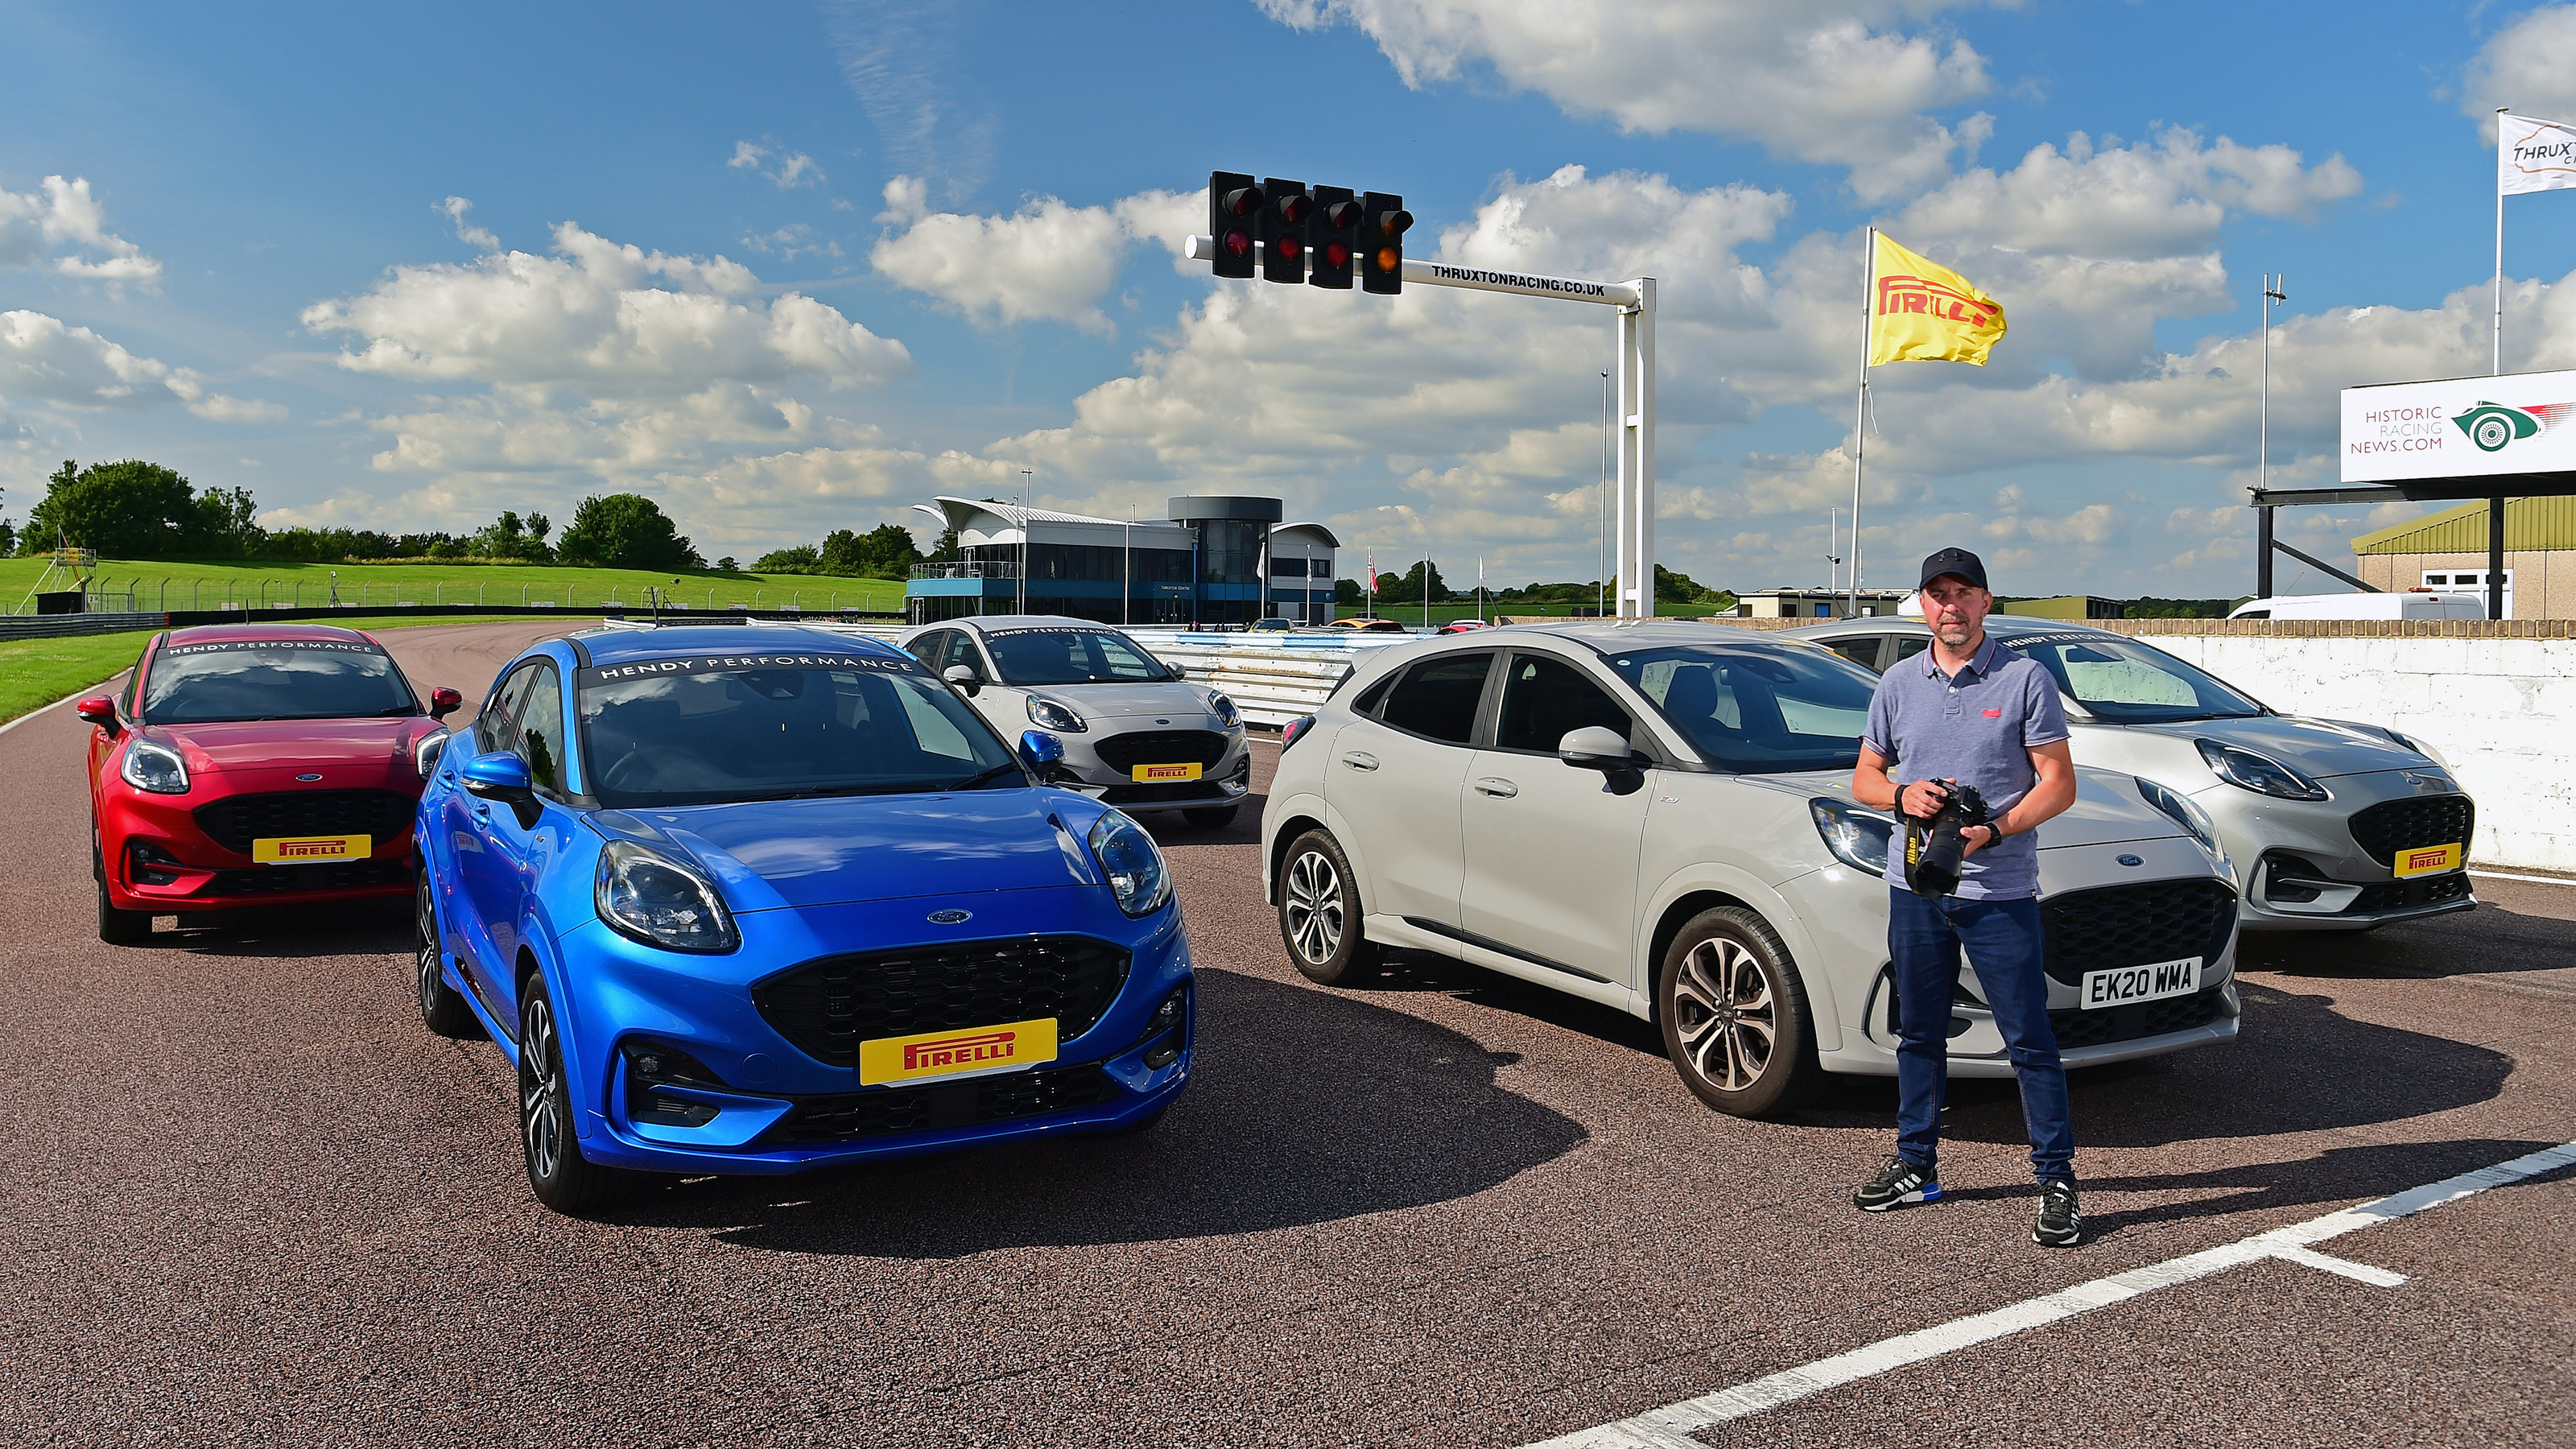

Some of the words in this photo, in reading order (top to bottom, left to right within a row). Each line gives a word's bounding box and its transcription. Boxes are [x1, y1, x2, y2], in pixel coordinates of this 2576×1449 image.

[2513, 142, 2576, 162] THRUX
[1432, 265, 1605, 296] THRUXTONRACING.CO.UK
[2366, 407, 2442, 423] HISTORIC
[2380, 422, 2442, 437] RACING
[2351, 438, 2442, 454] NEWS.COM
[990, 629, 1029, 638] HENDY
[1033, 628, 1119, 637] PERFORMANCE
[2002, 634, 2050, 647] HENDY
[169, 643, 229, 655] HENDY
[237, 642, 373, 653] PERFORMANCE
[601, 659, 693, 679] HENDY
[708, 656, 914, 673] PERFORMANCE
[1147, 766, 1187, 778] PIRELLI
[279, 840, 346, 857] PIRELLI
[1906, 836, 1917, 865] Nikon
[2409, 849, 2447, 869] PIRELLI
[2091, 968, 2150, 1003] EK20
[2154, 962, 2192, 994] WMA
[903, 1031, 1016, 1070] PIRELLI
